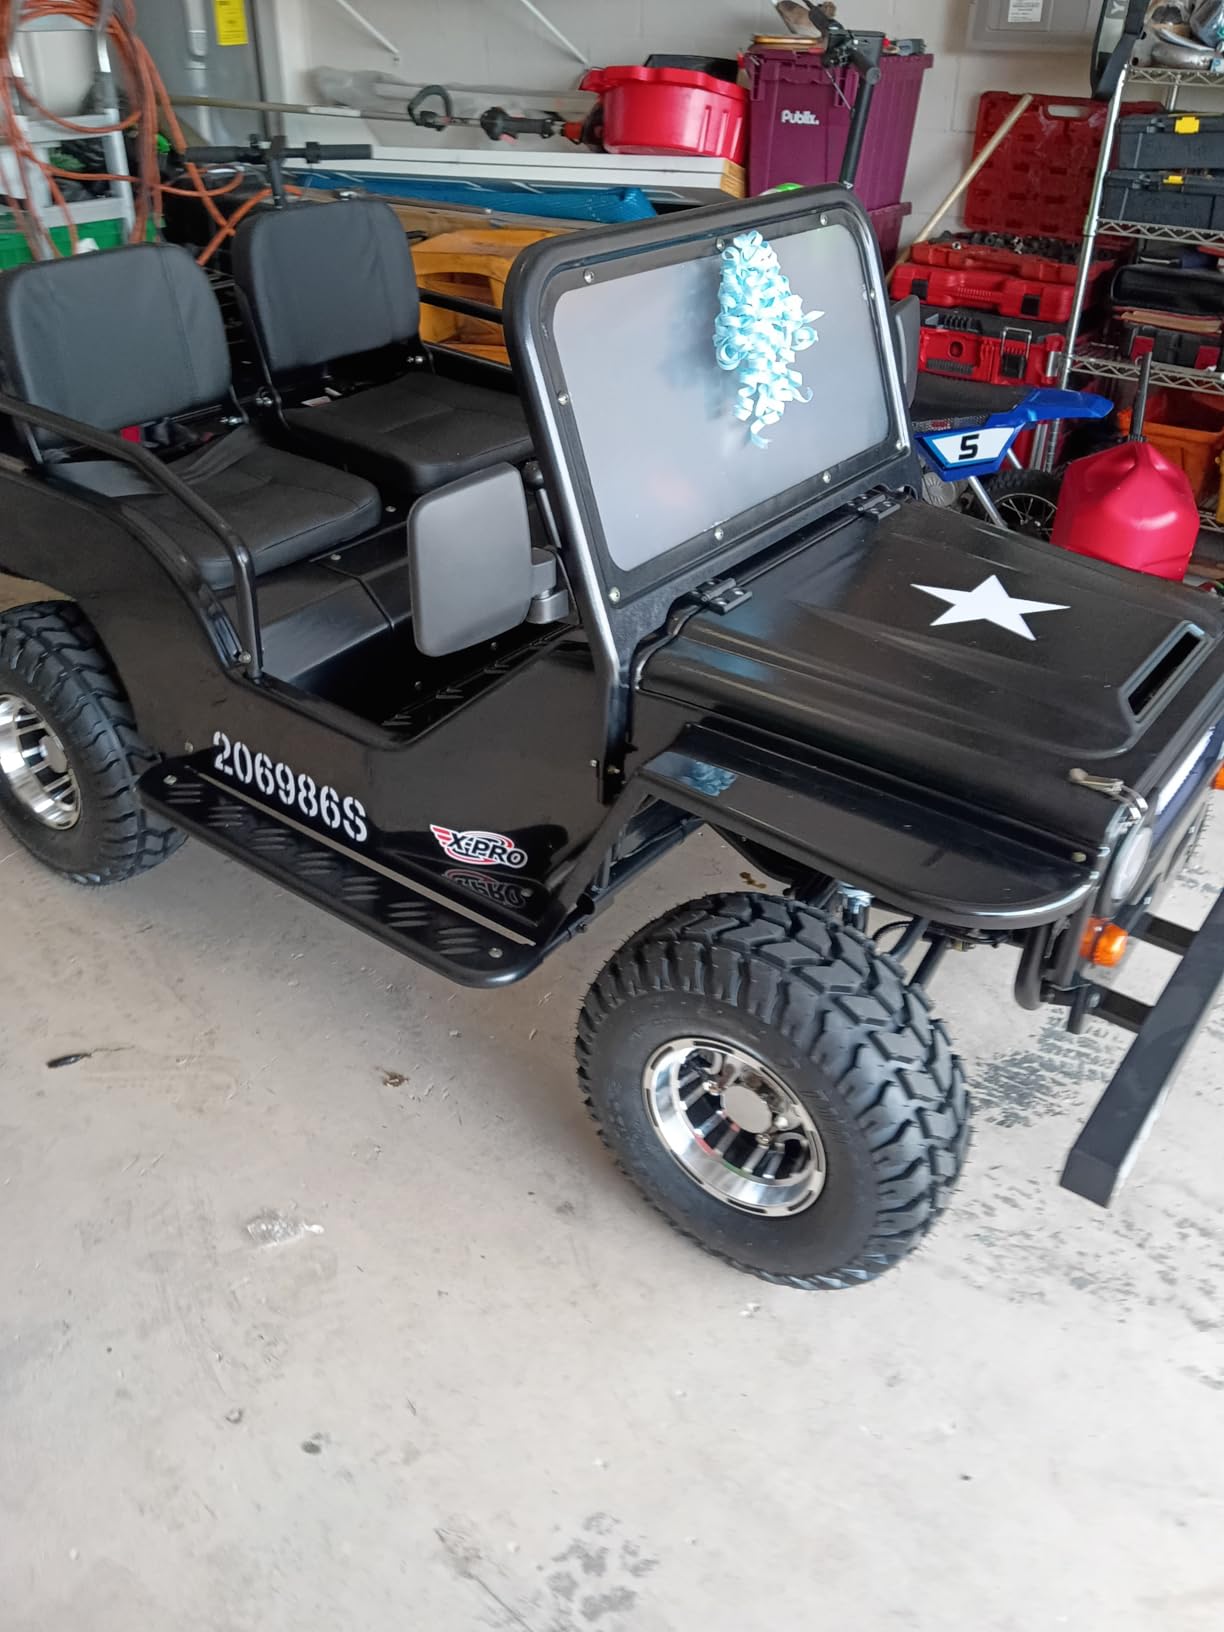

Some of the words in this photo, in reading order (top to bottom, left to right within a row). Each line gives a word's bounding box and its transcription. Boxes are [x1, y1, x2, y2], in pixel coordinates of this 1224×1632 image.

[958, 433, 980, 460] 5
[213, 731, 368, 842] 206986S
[447, 832, 525, 866] X-PRO
